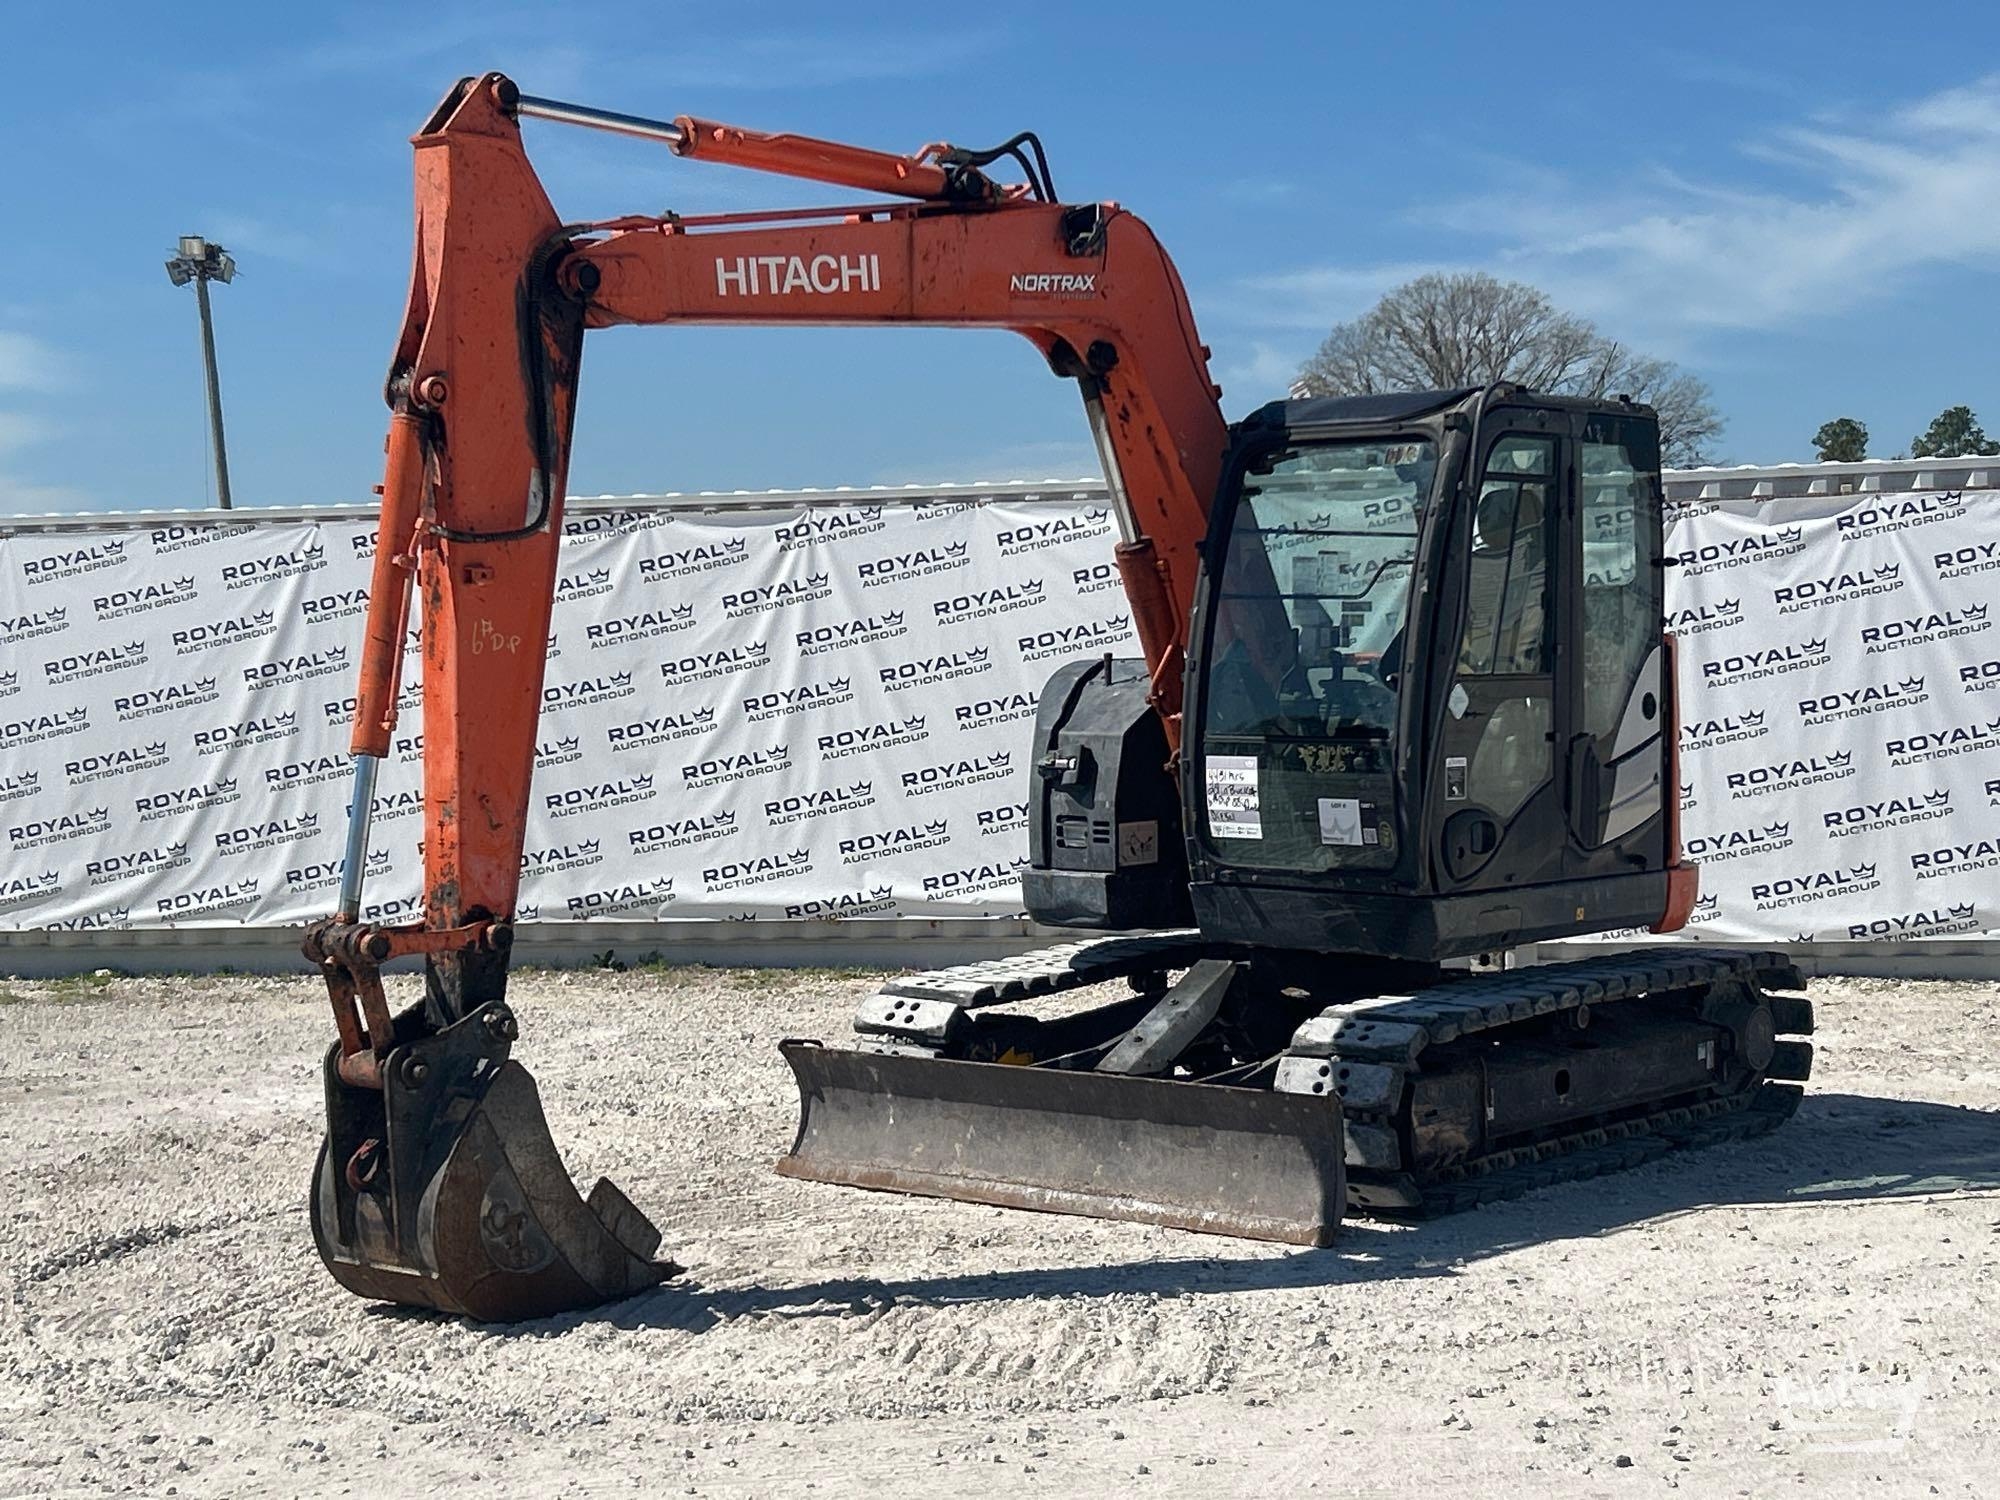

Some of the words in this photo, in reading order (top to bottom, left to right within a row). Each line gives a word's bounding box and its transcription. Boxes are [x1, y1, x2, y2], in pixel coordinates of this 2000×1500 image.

[716, 254, 880, 296] HITACHI
[1010, 274, 1096, 292] NORTRAX
[775, 514, 860, 542] ROYAL
[1836, 499, 1937, 530] ROYAL
[1842, 520, 1909, 541] AUCTION
[1912, 508, 1966, 526] GROUP
[779, 535, 837, 552] AUCTION
[839, 522, 886, 539] GROUP
[997, 517, 1085, 546] ROYAL
[1001, 536, 1060, 556] AUCTION
[1062, 526, 1110, 542] GROUP
[23, 548, 104, 575] ROYAL
[639, 545, 724, 573] ROYAL
[858, 549, 945, 578] ROYAL
[1679, 535, 1777, 566] ROYAL
[1684, 555, 1750, 576] AUCTION
[1752, 544, 1806, 562] GROUP
[28, 566, 82, 584] AUCTION
[84, 556, 127, 571] GROUP
[222, 552, 303, 580] ROYAL
[227, 571, 282, 590] AUCTION
[283, 561, 327, 577] GROUP
[644, 564, 701, 583] AUCTION
[703, 554, 749, 570] GROUP
[863, 568, 921, 588] AUCTION
[923, 558, 970, 574] GROUP
[94, 583, 174, 611] ROYAL
[722, 580, 807, 609] ROYAL
[934, 587, 1021, 616] ROYAL
[1774, 572, 1874, 603] ROYAL
[1780, 593, 1847, 614] AUCTION
[1849, 581, 1904, 599] GROUP
[98, 602, 152, 621] AUCTION
[154, 592, 198, 608] GROUP
[727, 599, 784, 619] AUCTION
[786, 589, 832, 605] GROUP
[938, 606, 997, 626] AUCTION
[999, 596, 1046, 612] GROUP
[173, 618, 253, 645] ROYAL
[586, 611, 672, 639] ROYAL
[591, 630, 649, 649] AUCTION
[651, 620, 697, 636] GROUP
[796, 618, 882, 646] ROYAL
[1018, 623, 1107, 651] ROYAL
[1861, 612, 1962, 643] ROYAL
[1867, 633, 1935, 654] AUCTION
[1937, 622, 1992, 639] GROUP
[177, 636, 231, 655] AUCTION
[233, 626, 276, 642] GROUP
[801, 637, 858, 656] AUCTION
[861, 627, 907, 643] GROUP
[1023, 641, 1083, 660] AUCTION
[1085, 631, 1133, 647] GROUP
[44, 648, 124, 675] ROYAL
[49, 666, 103, 685] AUCTION
[105, 657, 148, 672] GROUP
[243, 654, 326, 681] ROYAL
[661, 649, 746, 676] ROYAL
[666, 667, 723, 686] AUCTION
[725, 658, 771, 673] GROUP
[880, 654, 966, 682] ROYAL
[1702, 647, 1802, 677] ROYAL
[1708, 667, 1775, 688] AUCTION
[1777, 656, 1831, 673] GROUP
[248, 672, 303, 691] AUCTION
[305, 662, 350, 678] GROUP
[885, 673, 943, 692] AUCTION
[945, 663, 992, 679] GROUP
[115, 684, 195, 711] ROYAL
[119, 703, 173, 721] AUCTION
[175, 693, 219, 708] GROUP
[743, 684, 829, 712] ROYAL
[748, 703, 805, 722] AUCTION
[807, 693, 854, 709] GROUP
[956, 690, 1039, 720] ROYAL
[1799, 685, 1899, 715] ROYAL
[1804, 705, 1872, 726] AUCTION
[1874, 694, 1929, 712] GROUP
[194, 719, 275, 746] ROYAL
[608, 714, 693, 742] ROYAL
[960, 710, 1019, 731] AUCTION
[199, 737, 253, 756] AUCTION
[255, 727, 299, 743] GROUP
[613, 733, 670, 752] AUCTION
[672, 723, 718, 739] GROUP
[818, 722, 904, 750] ROYAL
[822, 741, 880, 760] AUCTION
[882, 732, 929, 748] GROUP
[1886, 725, 1988, 756] ROYAL
[65, 748, 146, 775] ROYAL
[682, 752, 767, 779] ROYAL
[1891, 746, 1959, 767] AUCTION
[70, 767, 124, 785] AUCTION
[126, 757, 169, 772] GROUP
[687, 771, 744, 789] AUCTION
[746, 761, 792, 777] GROUP
[901, 759, 988, 787] ROYAL
[906, 778, 965, 797] AUCTION
[967, 768, 1014, 784] GROUP
[1727, 759, 1826, 788] ROYAL
[1732, 779, 1799, 799] AUCTION
[1802, 768, 1855, 785] GROUP
[136, 785, 217, 812] ROYAL
[141, 803, 195, 821] AUCTION
[197, 794, 240, 809] GROUP
[546, 781, 632, 808] ROYAL
[551, 800, 608, 818] AUCTION
[610, 791, 657, 806] GROUP
[765, 788, 850, 816] ROYAL
[769, 807, 827, 826] AUCTION
[829, 798, 875, 813] GROUP
[1823, 797, 1924, 827] ROYAL
[1829, 818, 1897, 838] AUCTION
[1899, 807, 1954, 825] GROUP
[8, 814, 88, 841] ROYAL
[13, 832, 67, 850] AUCTION
[68, 823, 111, 838] GROUP
[215, 820, 297, 847] ROYAL
[629, 817, 714, 845] ROYAL
[634, 836, 691, 854] AUCTION
[693, 827, 739, 842] GROUP
[839, 827, 925, 854] ROYAL
[220, 838, 275, 856] AUCTION
[276, 828, 321, 844] GROUP
[844, 846, 902, 864] AUCTION
[904, 836, 950, 852] GROUP
[86, 849, 167, 876] ROYAL
[91, 867, 145, 885] AUCTION
[147, 858, 191, 873] GROUP
[703, 856, 788, 883] ROYAL
[923, 862, 1012, 891] ROYAL
[1916, 861, 1984, 880] AUCTION
[707, 875, 764, 893] AUCTION
[766, 865, 813, 881] GROUP
[1751, 871, 1851, 900] ROYAL
[157, 885, 237, 913] ROYAL
[217, 896, 261, 912] GROUP
[567, 884, 651, 912] ROYAL
[629, 894, 675, 910] GROUP
[1757, 891, 1824, 911] AUCTION
[1826, 881, 1880, 897] GROUP
